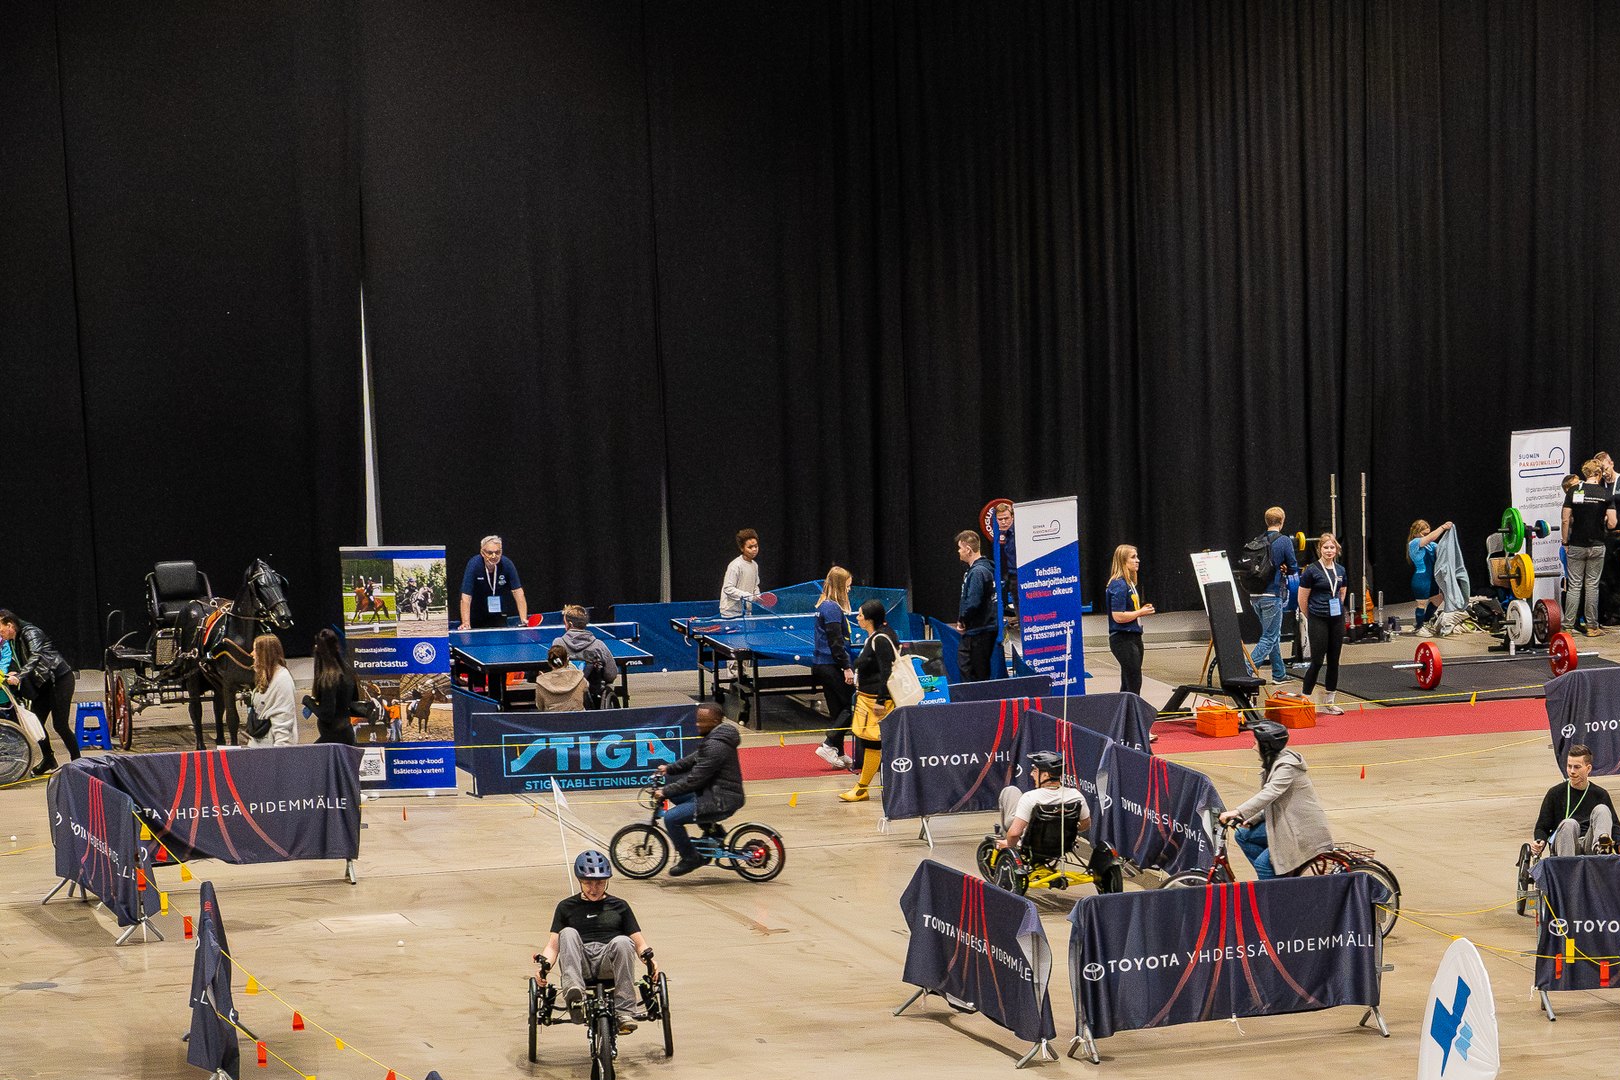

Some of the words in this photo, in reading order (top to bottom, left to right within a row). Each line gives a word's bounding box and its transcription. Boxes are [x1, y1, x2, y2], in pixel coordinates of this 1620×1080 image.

[1052, 586, 1074, 596] oikeus
[353, 660, 409, 668] Pararatsastus
[510, 732, 676, 773] STIGA
[919, 753, 979, 767] TOYOTA
[163, 802, 242, 820] YHDESSÄ
[249, 797, 348, 815] PIDEMMÄLLE
[1107, 954, 1180, 974] TOYOTA
[1185, 938, 1269, 967] YHDESSÄ
[1276, 930, 1375, 956] PIDEMMÄLL
